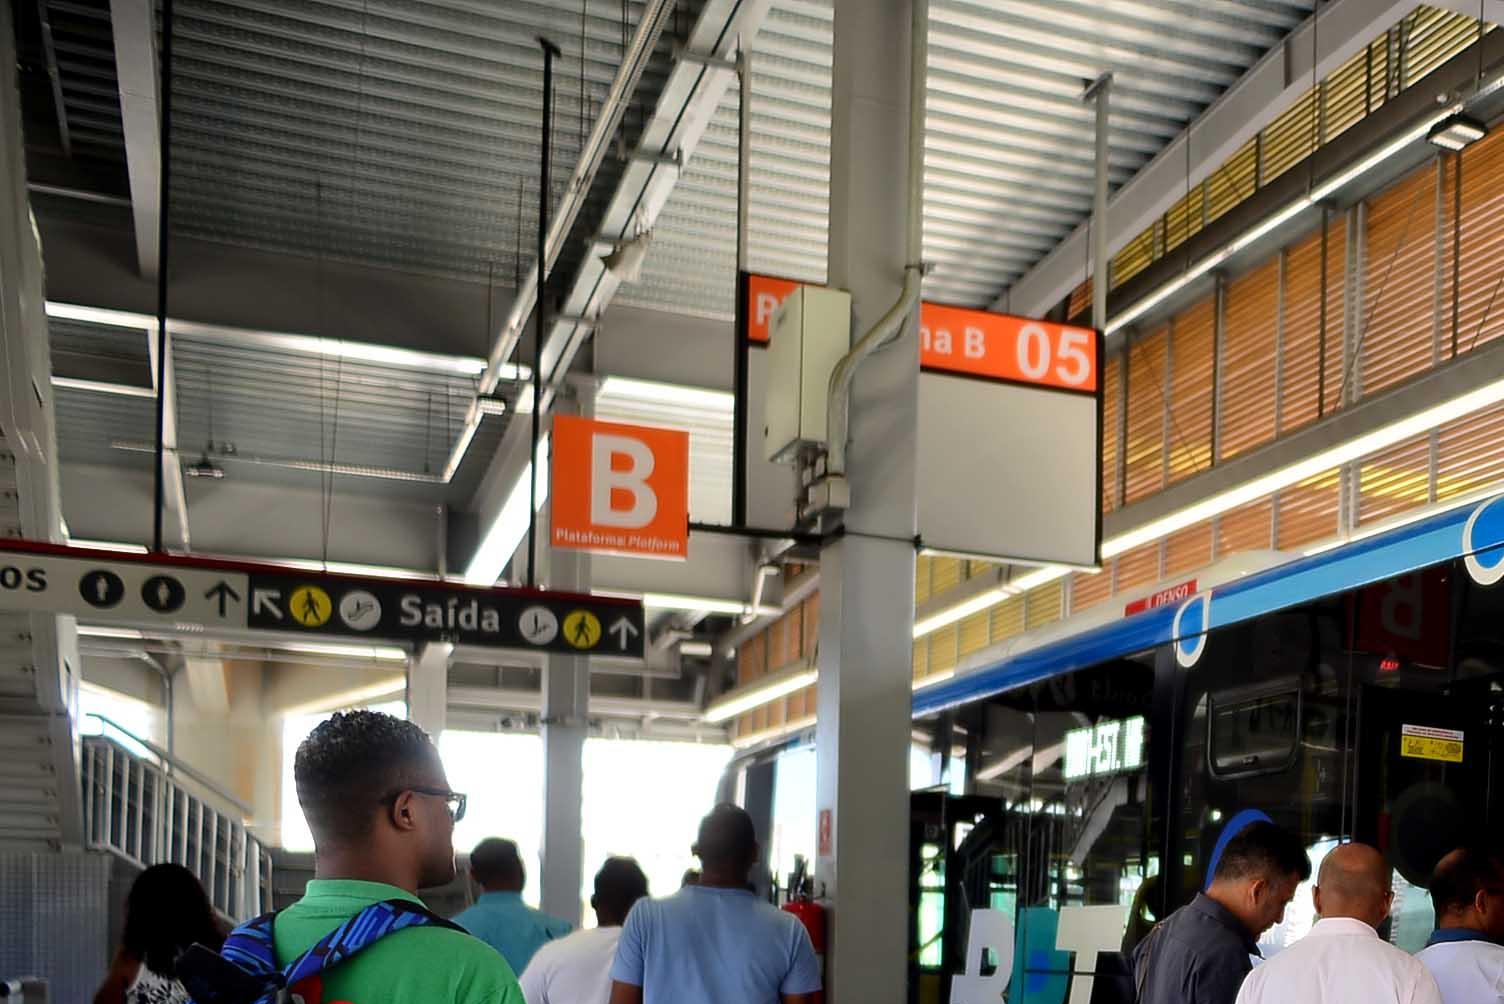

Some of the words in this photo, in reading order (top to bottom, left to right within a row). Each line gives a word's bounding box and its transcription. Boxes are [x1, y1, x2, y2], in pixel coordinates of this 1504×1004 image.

[964, 326, 987, 359] B
[1017, 323, 1091, 386] 05
[591, 432, 659, 530] B
[556, 527, 625, 546] Plataforma
[400, 594, 500, 633] Saída
[1155, 584, 1189, 607] DENSO
